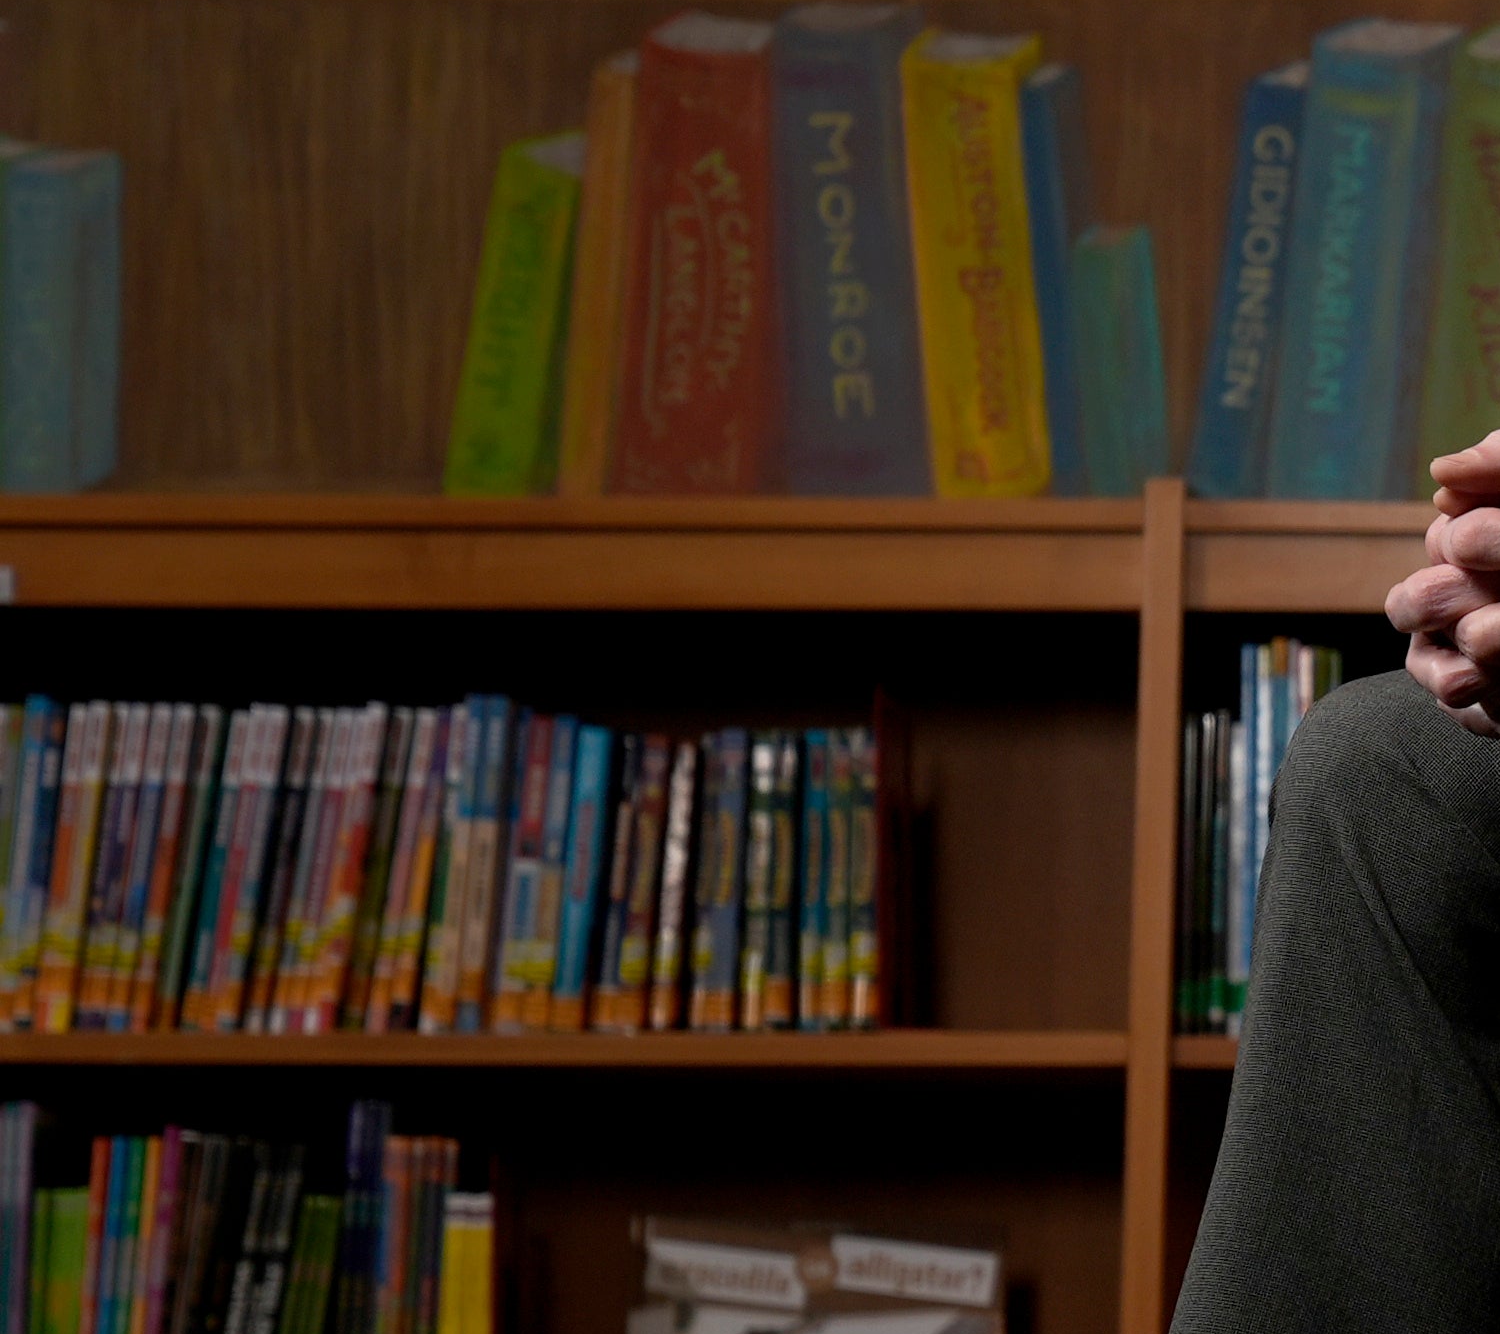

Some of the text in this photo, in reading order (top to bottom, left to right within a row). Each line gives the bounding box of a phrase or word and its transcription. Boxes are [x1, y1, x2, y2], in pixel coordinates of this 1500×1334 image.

[806, 109, 877, 422] MONROE
[1219, 124, 1295, 411] GIDIONSEN
[1305, 124, 1375, 417] MARKARIAN
